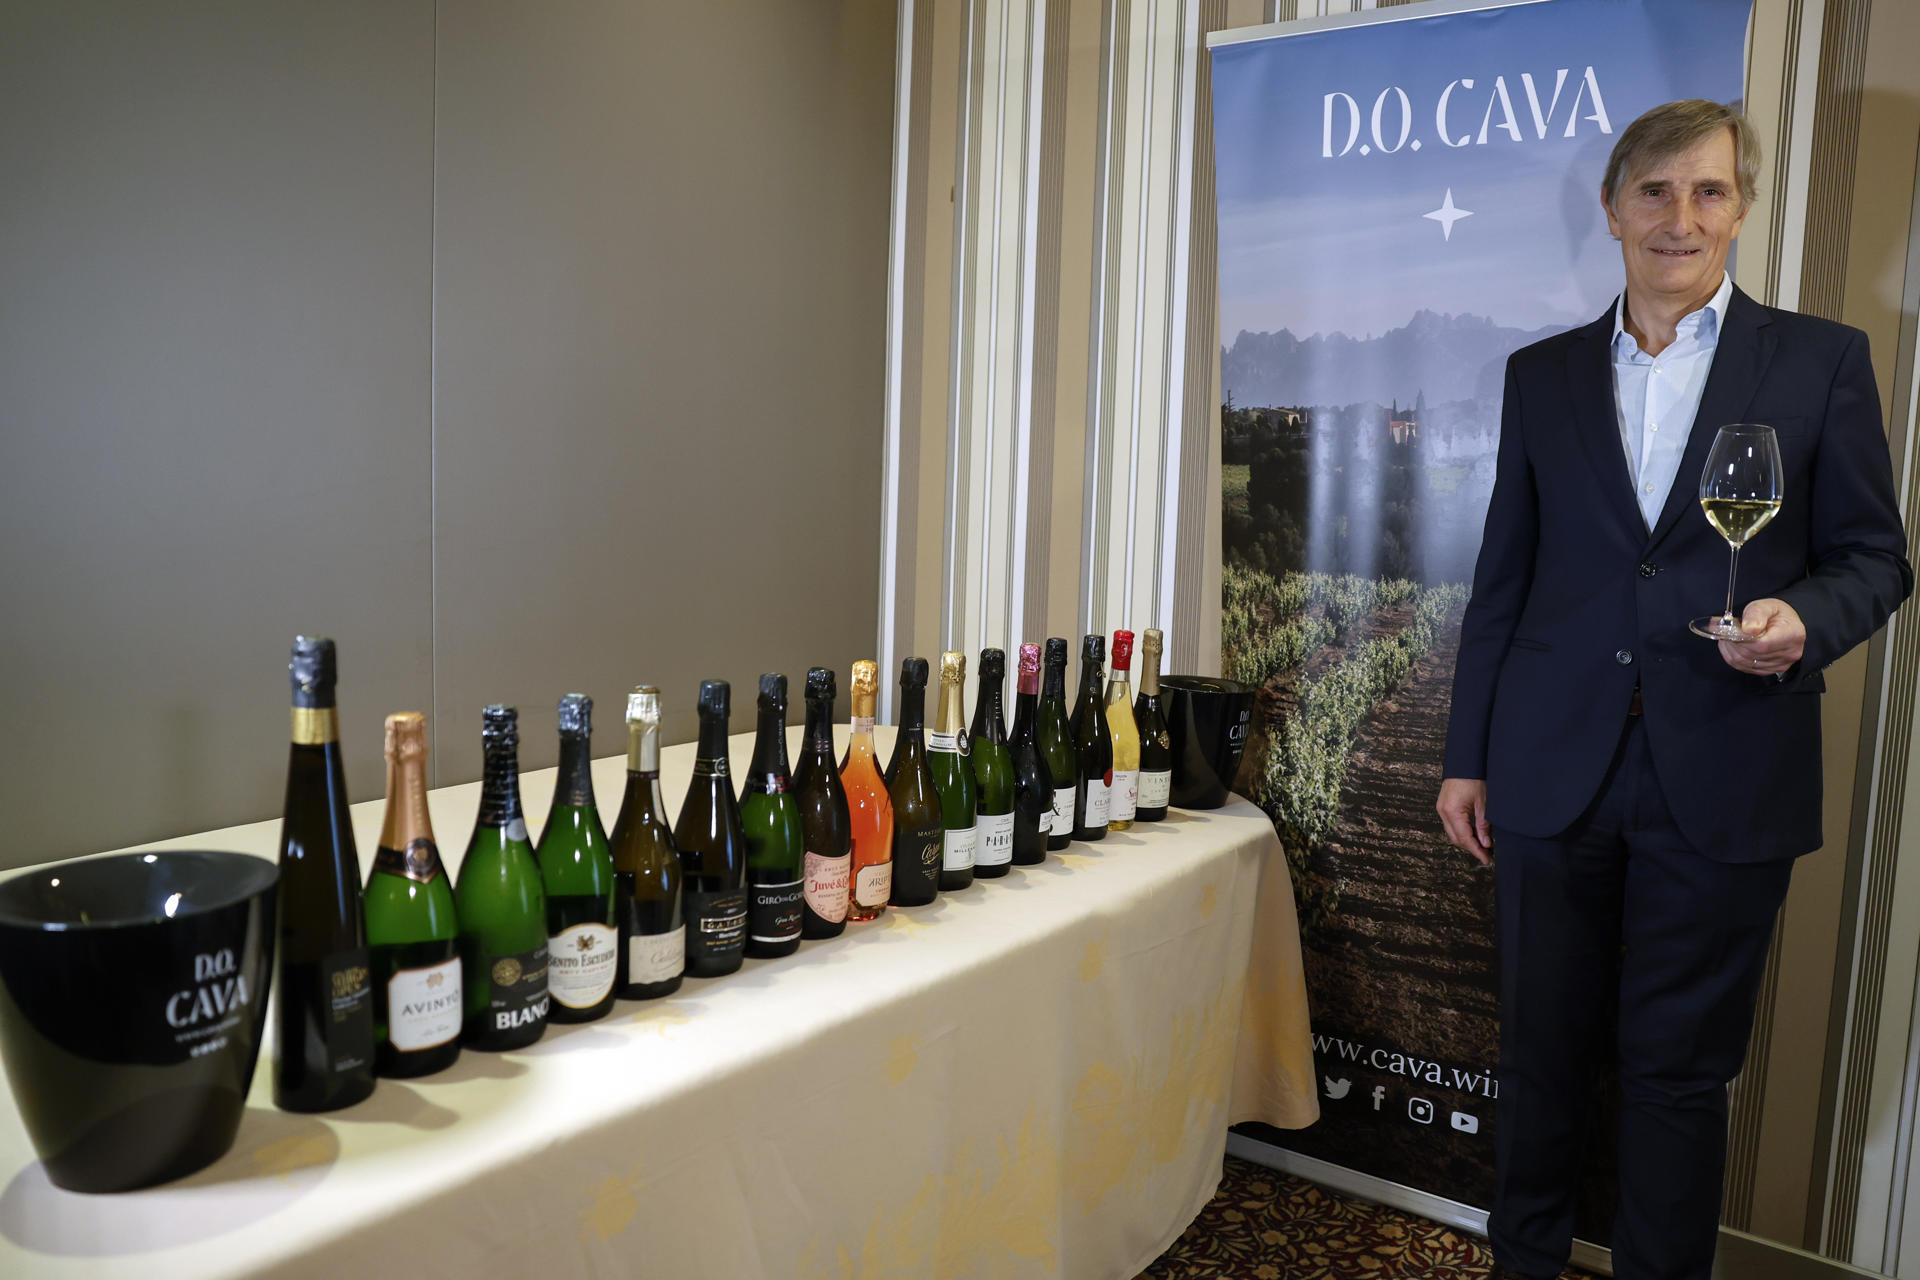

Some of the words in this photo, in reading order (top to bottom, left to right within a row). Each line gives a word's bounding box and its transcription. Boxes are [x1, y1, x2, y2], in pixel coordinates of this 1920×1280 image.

[1322, 86, 1422, 158] D.O.
[1435, 65, 1613, 147] CAVA
[165, 974, 248, 1028] CAVA
